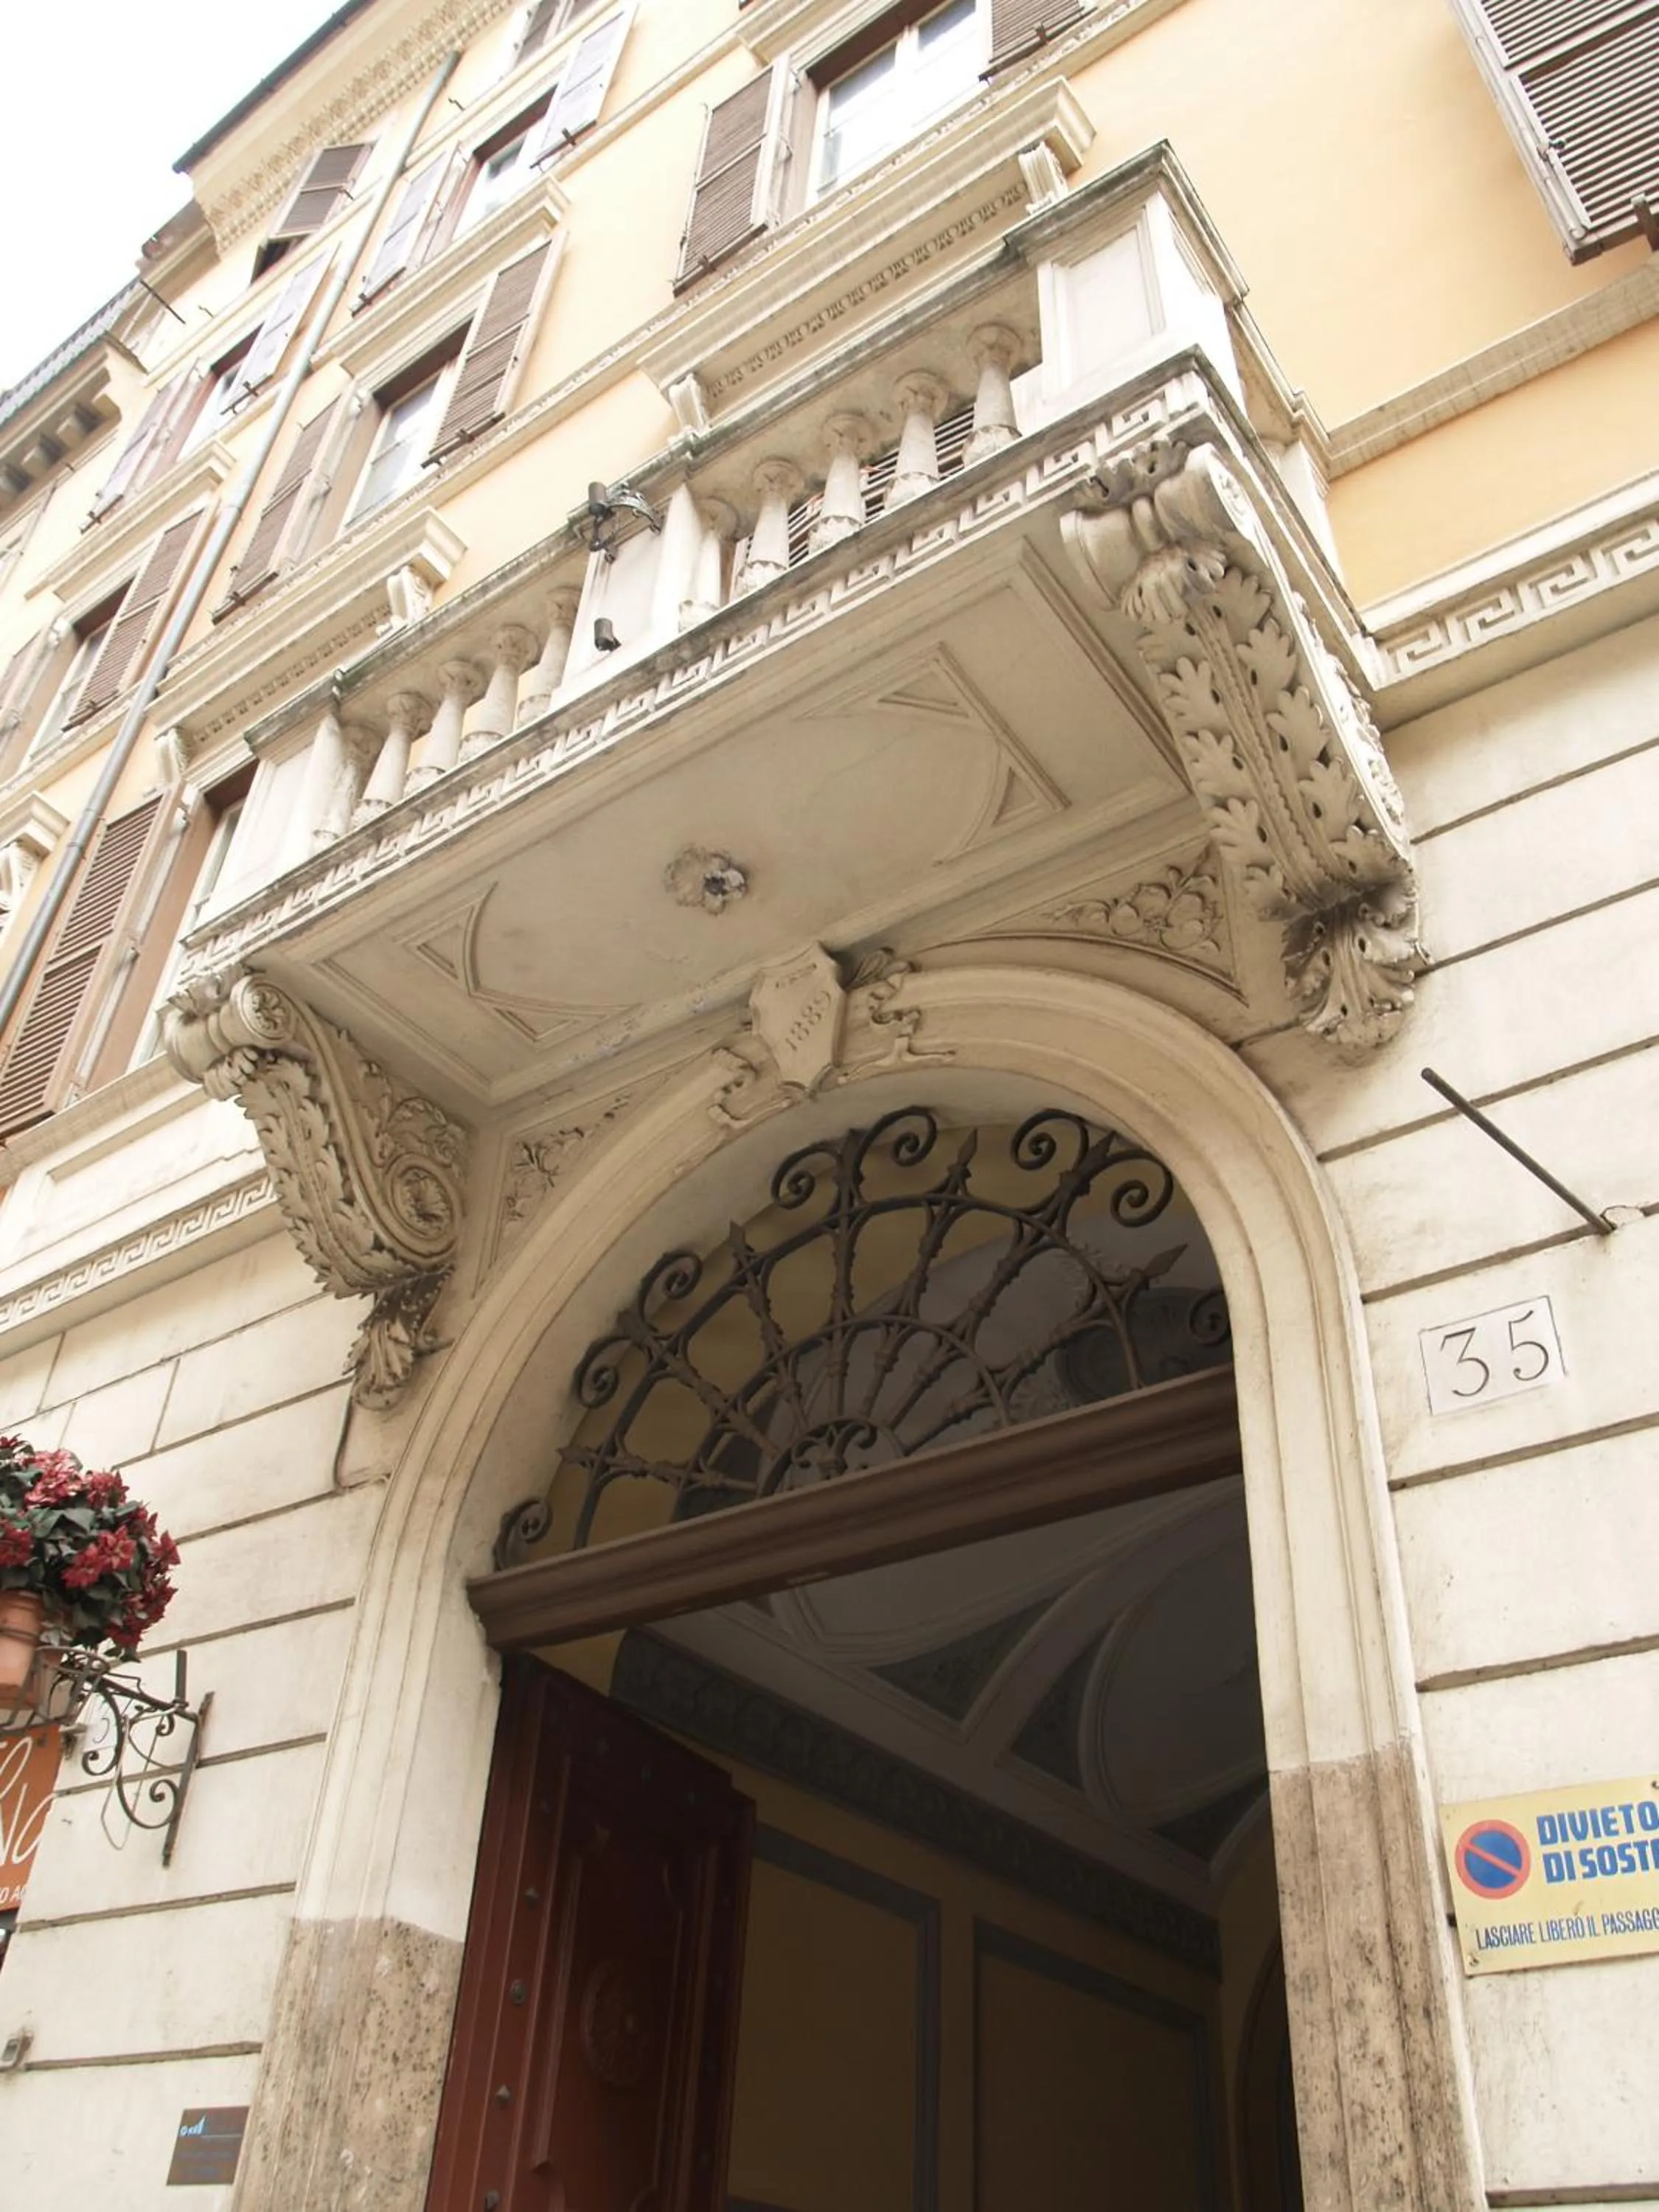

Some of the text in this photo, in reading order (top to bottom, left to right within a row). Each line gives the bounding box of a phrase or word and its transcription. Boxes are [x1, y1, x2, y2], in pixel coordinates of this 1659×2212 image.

[1439, 1310, 1549, 1397] 35
[1536, 1801, 1659, 1846] DIVIETO
[1542, 1849, 1576, 1884] DI
[1475, 1921, 1537, 1950] LASCIARE
[1586, 1914, 1601, 1938] IL
